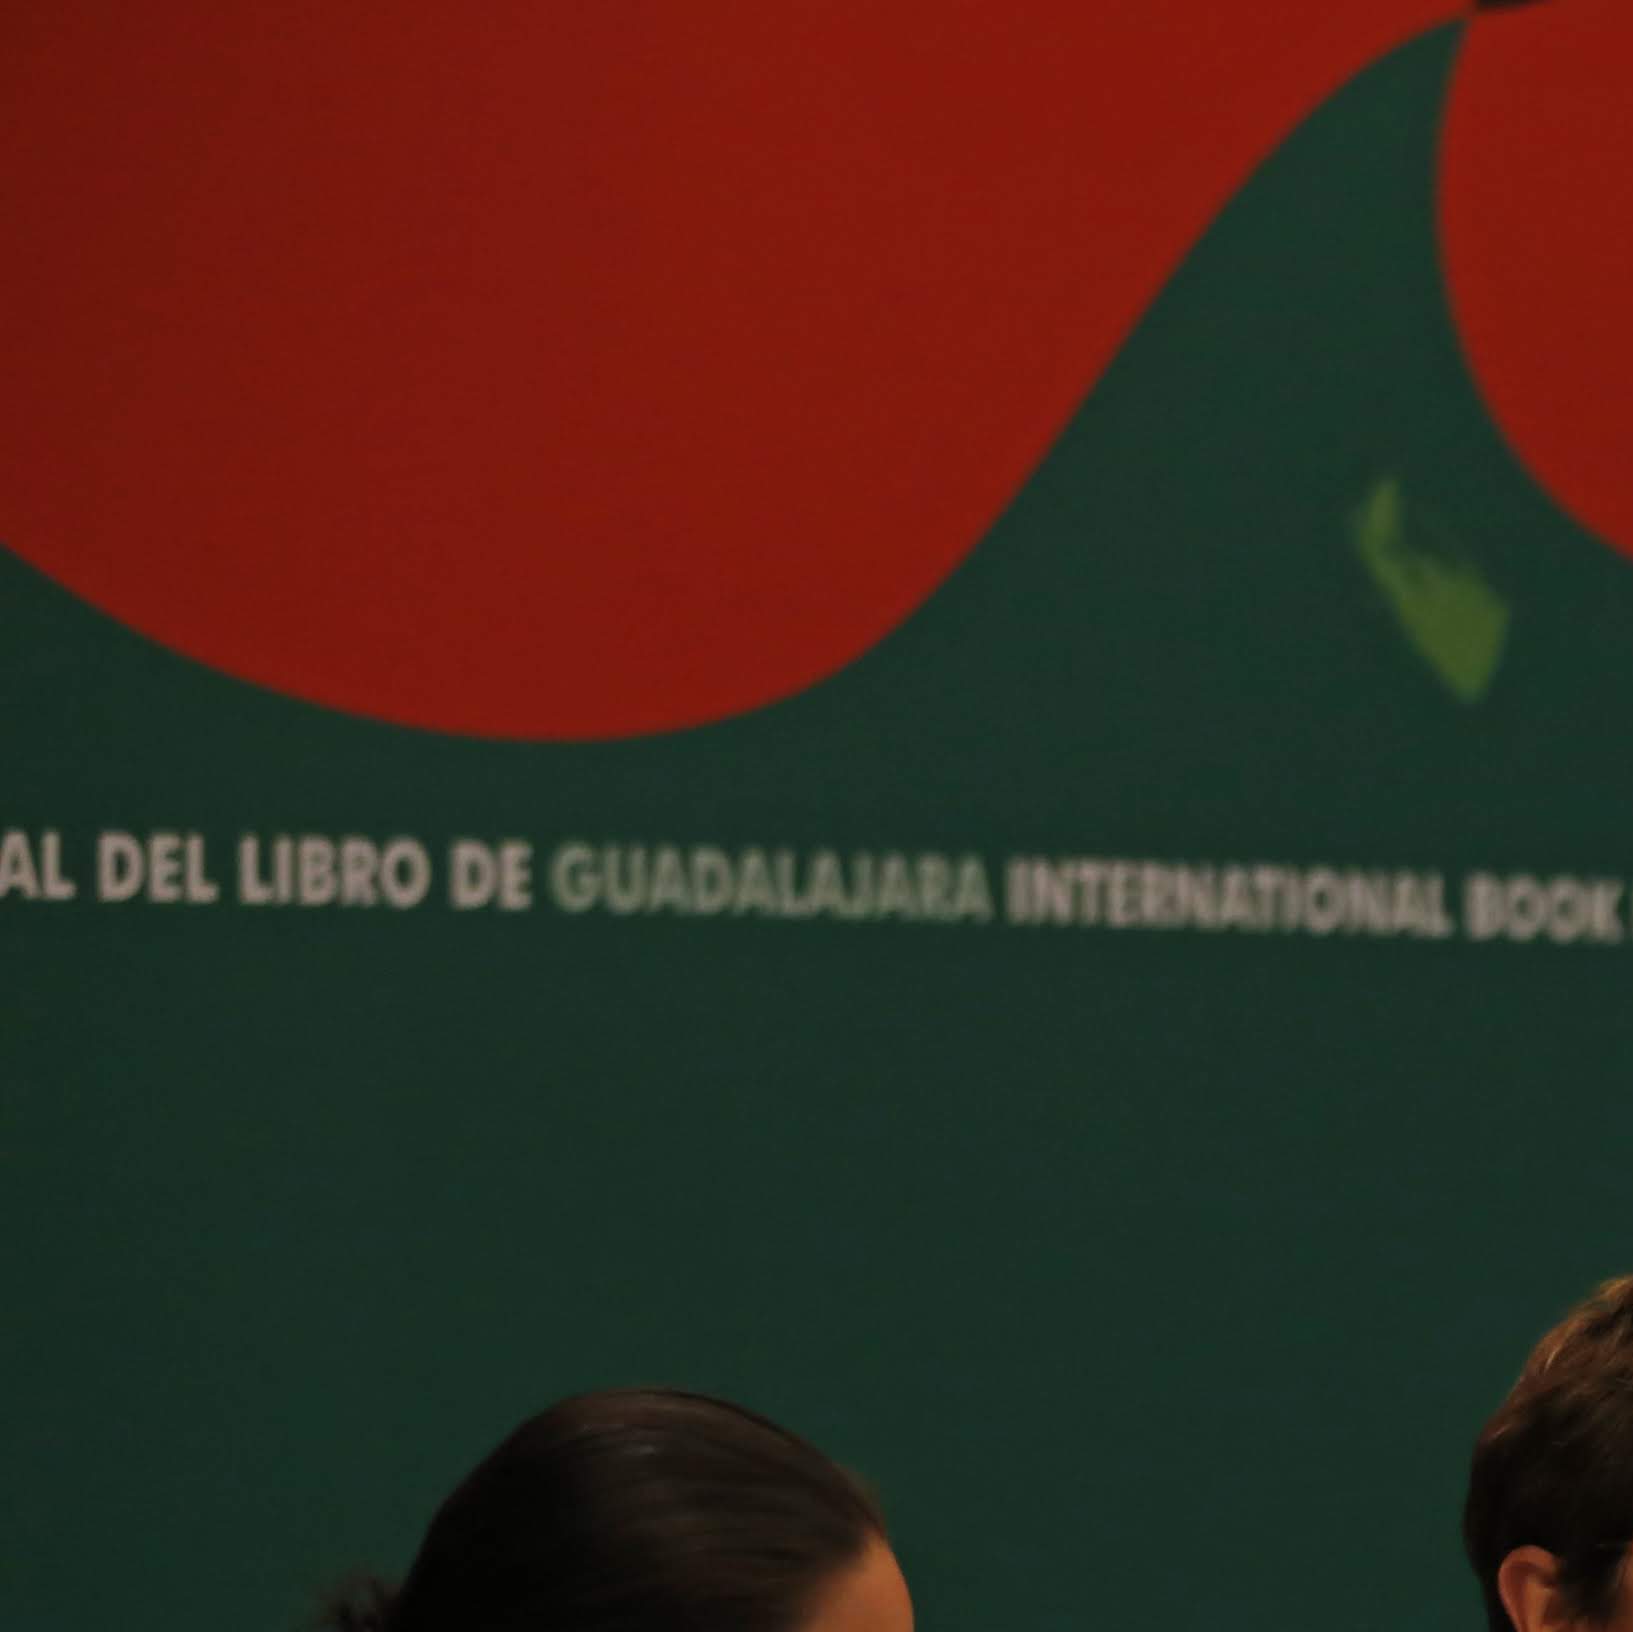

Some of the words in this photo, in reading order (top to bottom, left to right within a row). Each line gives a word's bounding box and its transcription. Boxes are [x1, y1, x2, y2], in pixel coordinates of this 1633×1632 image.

[0, 829, 76, 899] AL
[97, 829, 219, 902] DEL
[239, 831, 431, 908] LIBRO
[450, 837, 533, 910] DE
[550, 843, 993, 922] GUADALAJARA
[1006, 856, 1454, 939] INTERNATIONAL
[1466, 870, 1625, 945] BOOK
